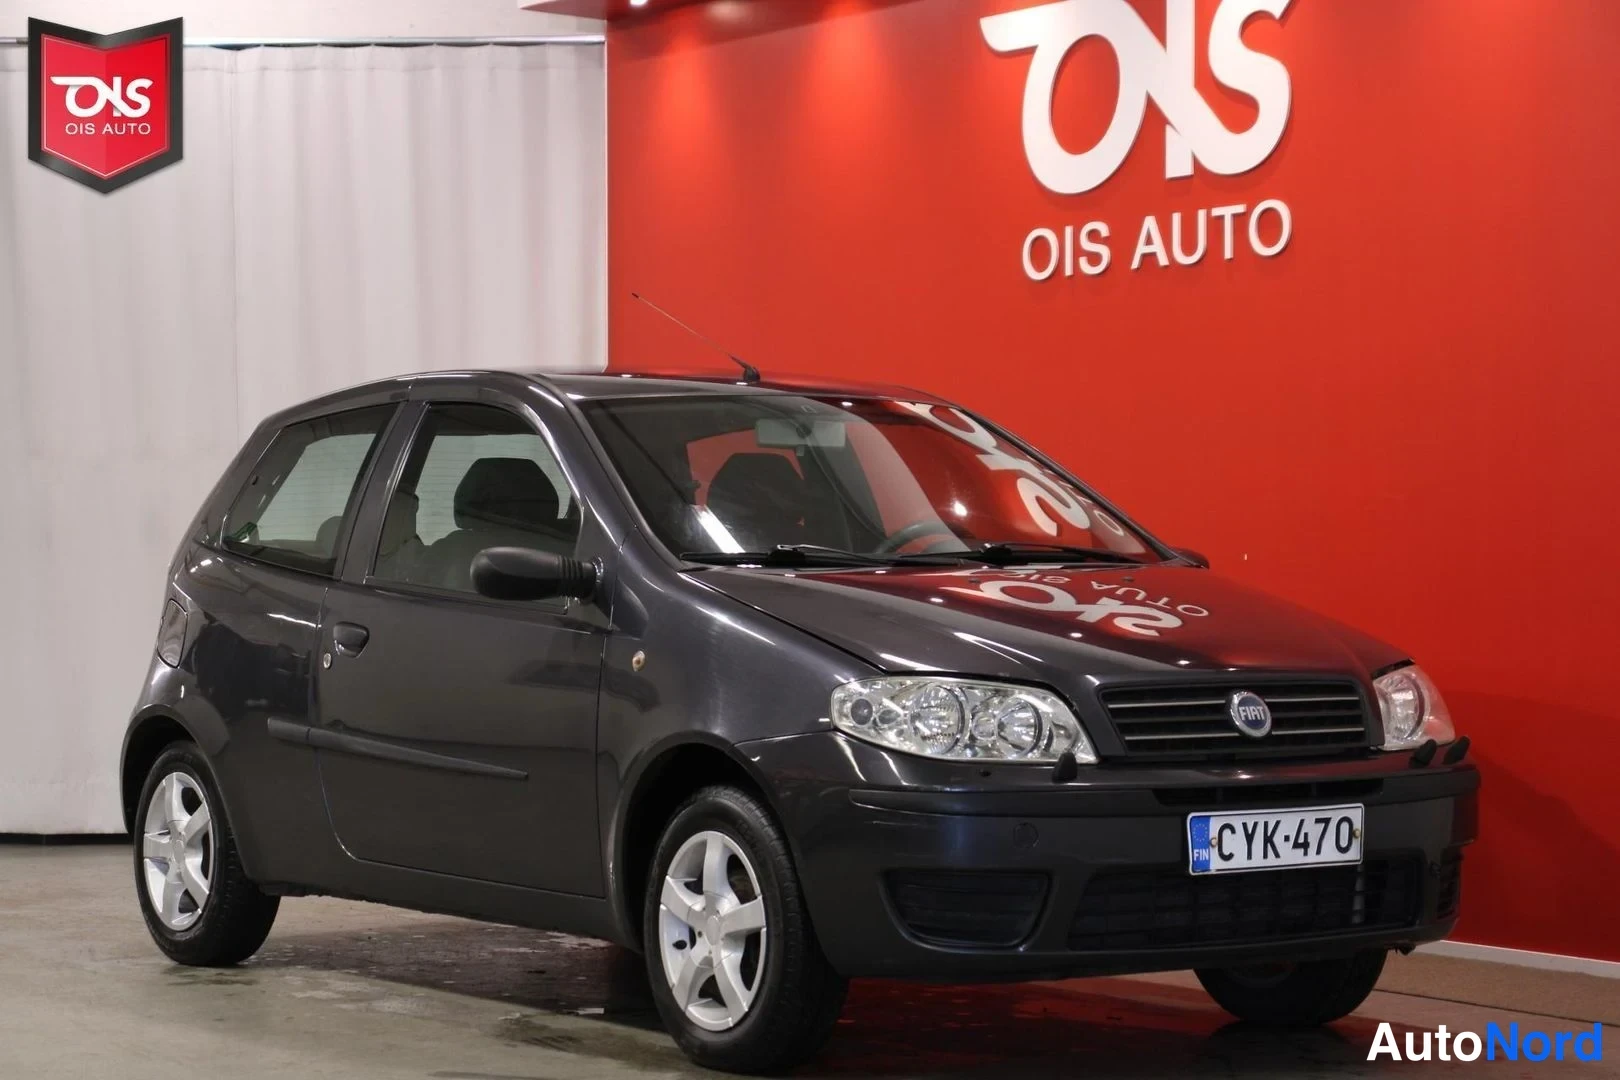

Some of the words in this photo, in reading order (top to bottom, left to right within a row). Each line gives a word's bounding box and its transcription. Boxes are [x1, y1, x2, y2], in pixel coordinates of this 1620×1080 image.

[980, 0, 1292, 195] OIS
[1022, 221, 1112, 281] OIS
[1131, 199, 1293, 270] AUTO
[1239, 705, 1265, 721] FIAT
[1194, 849, 1209, 862] FIN
[1217, 816, 1354, 862] CYK-470
